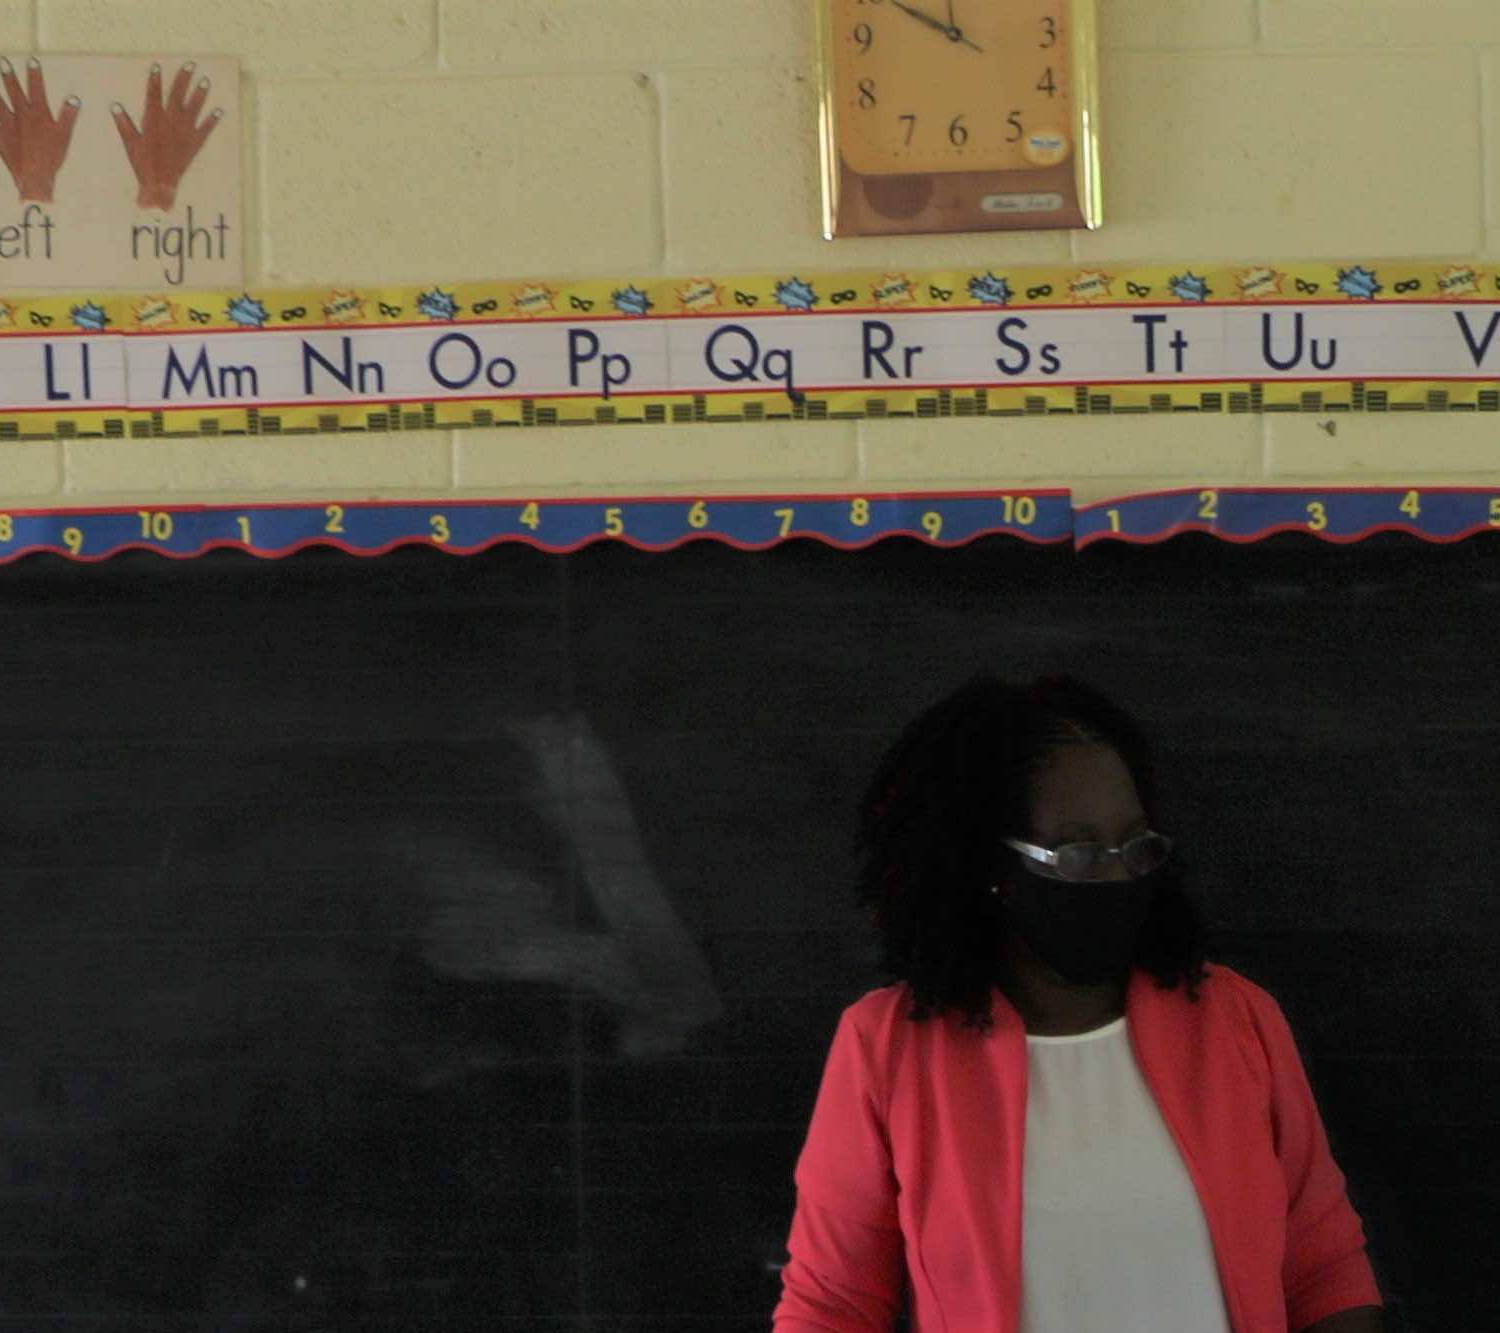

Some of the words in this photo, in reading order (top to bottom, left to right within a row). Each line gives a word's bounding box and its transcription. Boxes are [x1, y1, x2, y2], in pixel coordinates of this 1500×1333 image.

[853, 23, 873, 52] 9
[1038, 16, 1056, 49] 3
[857, 77, 876, 110] 8
[1036, 67, 1056, 97] 4
[899, 114, 916, 146] 7
[949, 113, 968, 146] 6
[1005, 110, 1023, 143] 5
[131, 205, 230, 284] right
[44, 343, 90, 400] Ll
[163, 346, 258, 399] Mm
[303, 336, 384, 393] Nn
[429, 333, 516, 389] Oo
[568, 328, 631, 399] Pp
[705, 324, 805, 403] Qq
[862, 320, 923, 376] Rr
[996, 317, 1060, 374] Ss
[1132, 314, 1188, 371] Tt
[1262, 312, 1336, 369] Uu
[64, 528, 83, 555] 9
[138, 513, 174, 540] 10
[237, 517, 250, 544] 1
[325, 507, 345, 532] 2
[429, 515, 450, 546] 3
[521, 504, 540, 528] 4
[605, 508, 624, 539] 5
[688, 502, 708, 528] 6
[775, 508, 795, 538] 7
[851, 499, 872, 526] 8
[922, 512, 943, 538] 9
[1001, 498, 1036, 524] 10
[1106, 510, 1121, 534] 1
[1198, 491, 1219, 518] 2
[1306, 502, 1328, 531] 3
[1400, 491, 1423, 517] 4
